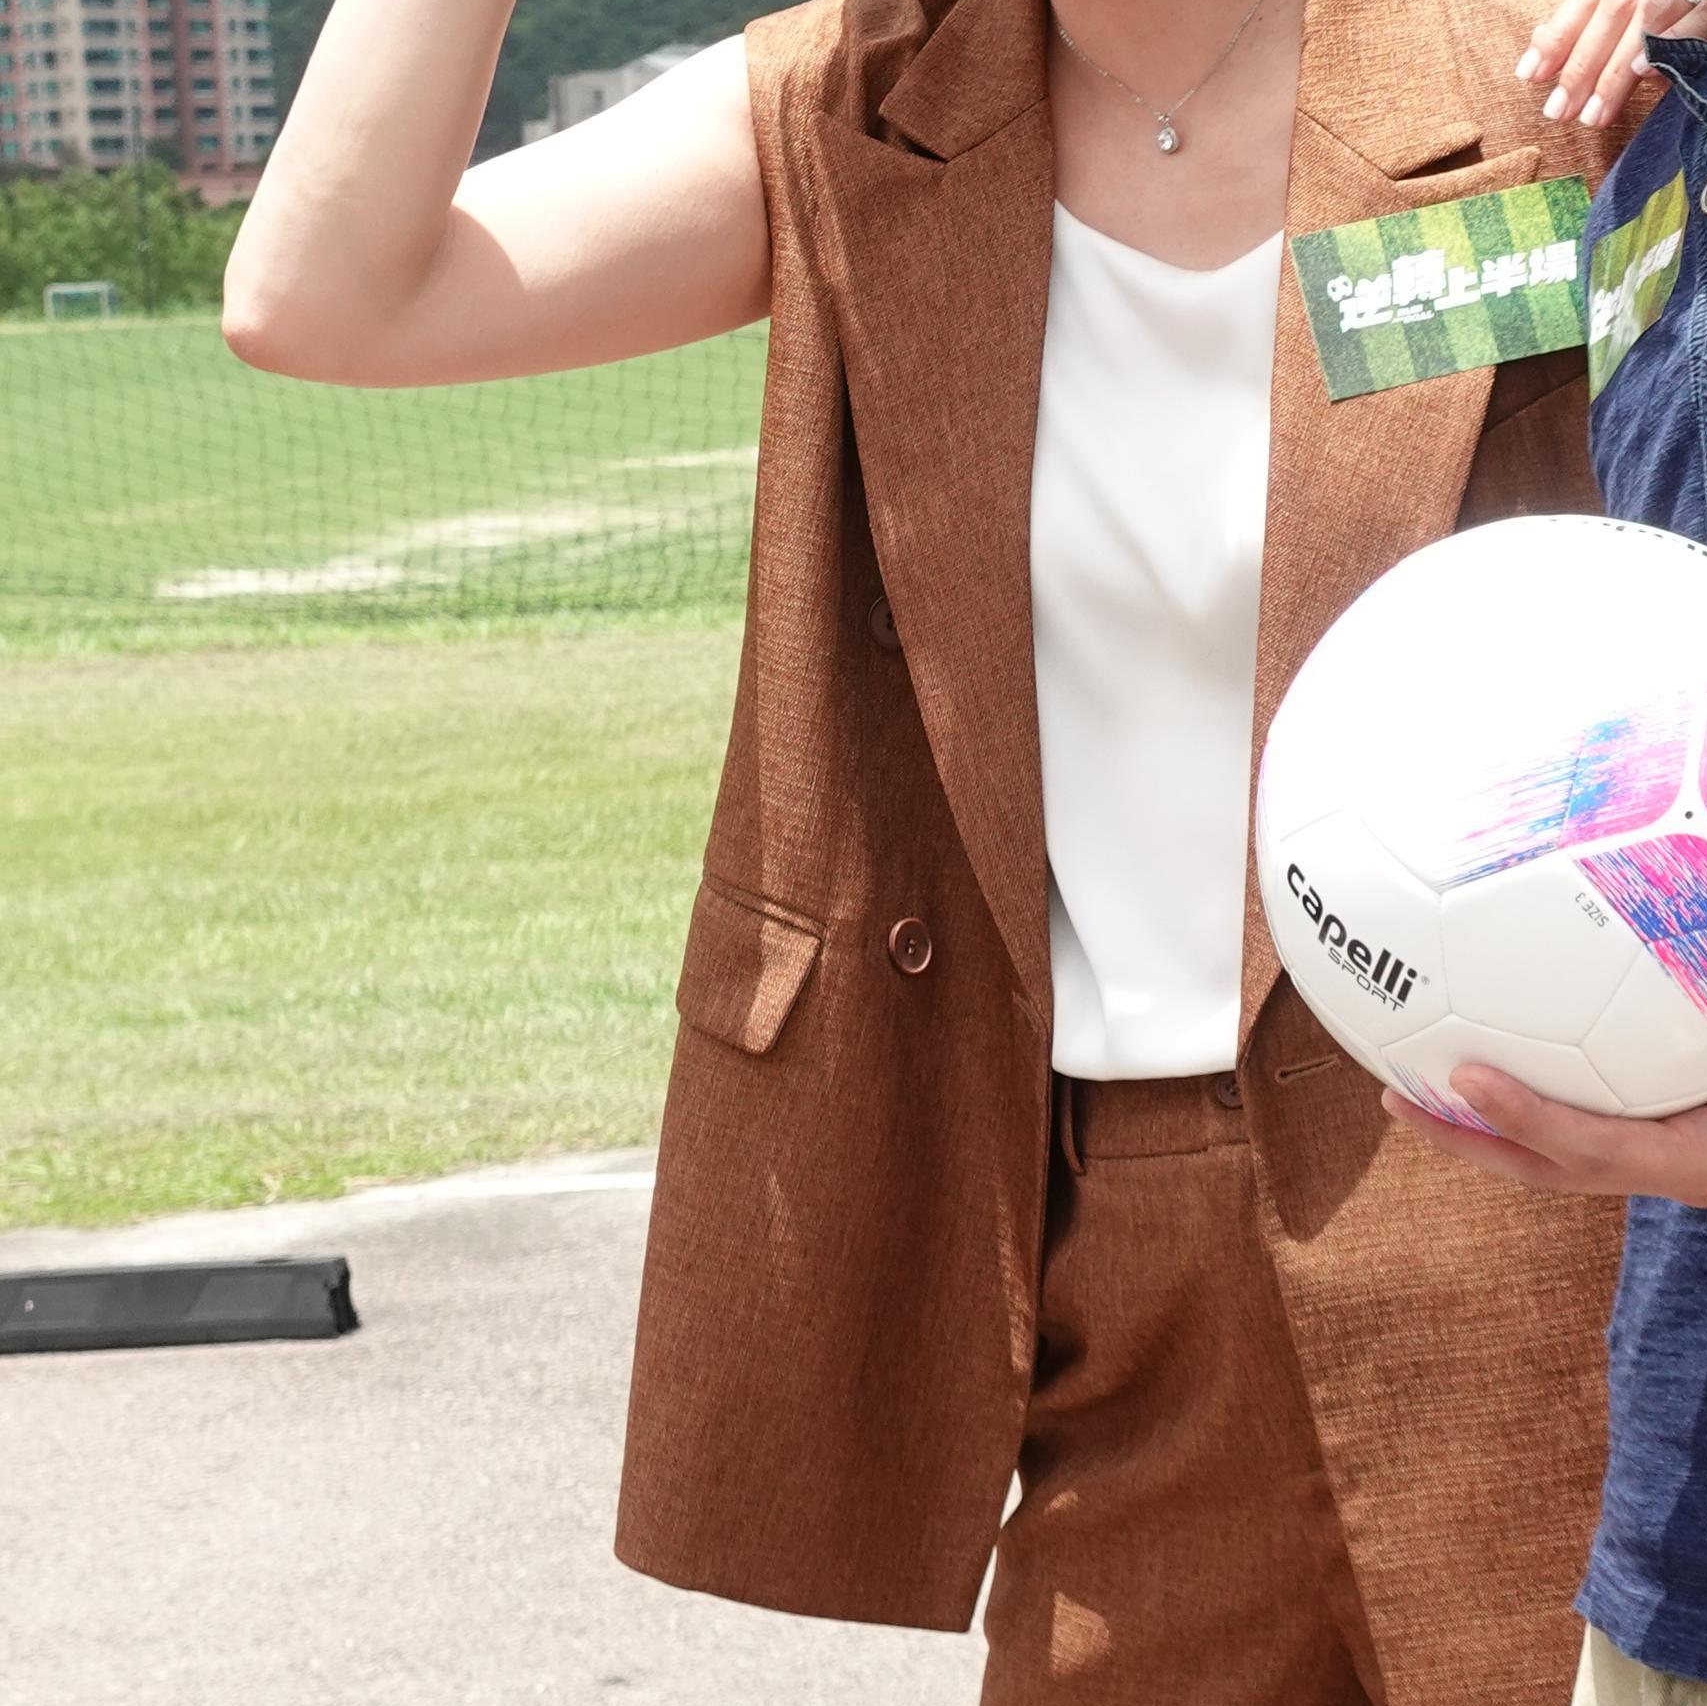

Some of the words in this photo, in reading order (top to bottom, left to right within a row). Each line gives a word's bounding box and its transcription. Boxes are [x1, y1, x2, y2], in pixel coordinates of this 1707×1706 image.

[1287, 863, 1417, 1004] capelli
[1582, 900, 1609, 927] SIZE
[1328, 947, 1404, 1011] SPORT
